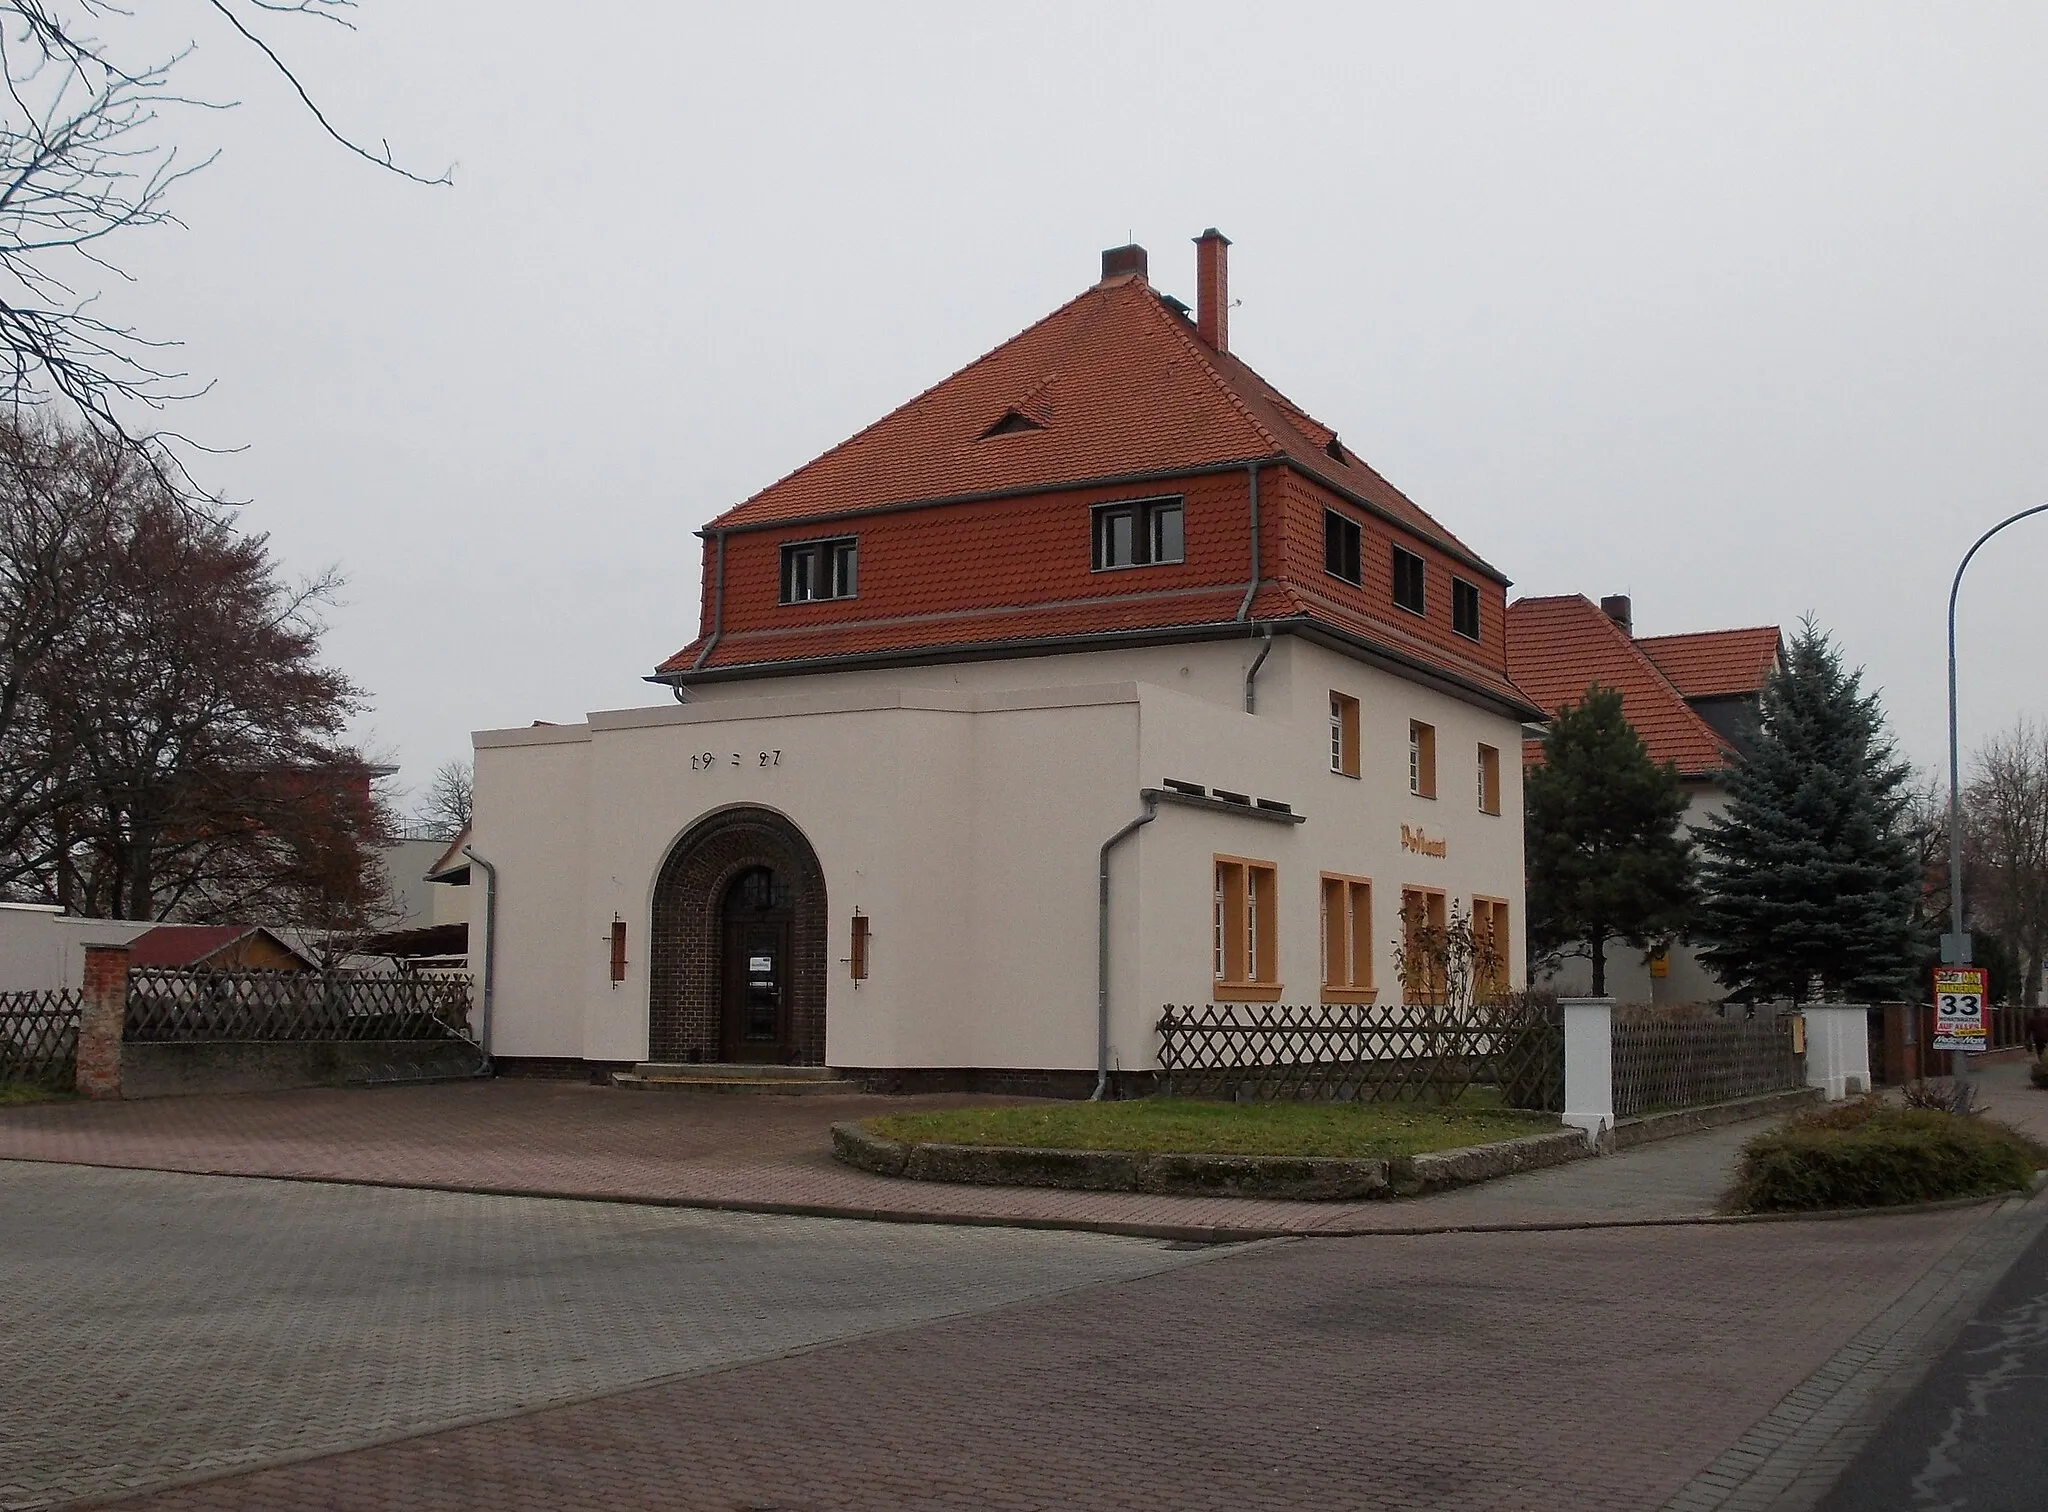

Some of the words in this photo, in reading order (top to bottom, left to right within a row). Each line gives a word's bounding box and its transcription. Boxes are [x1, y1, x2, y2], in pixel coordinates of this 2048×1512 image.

[690, 751, 716, 771] 19
[758, 749, 782, 768] 27
[1940, 995, 1979, 1016] 33
